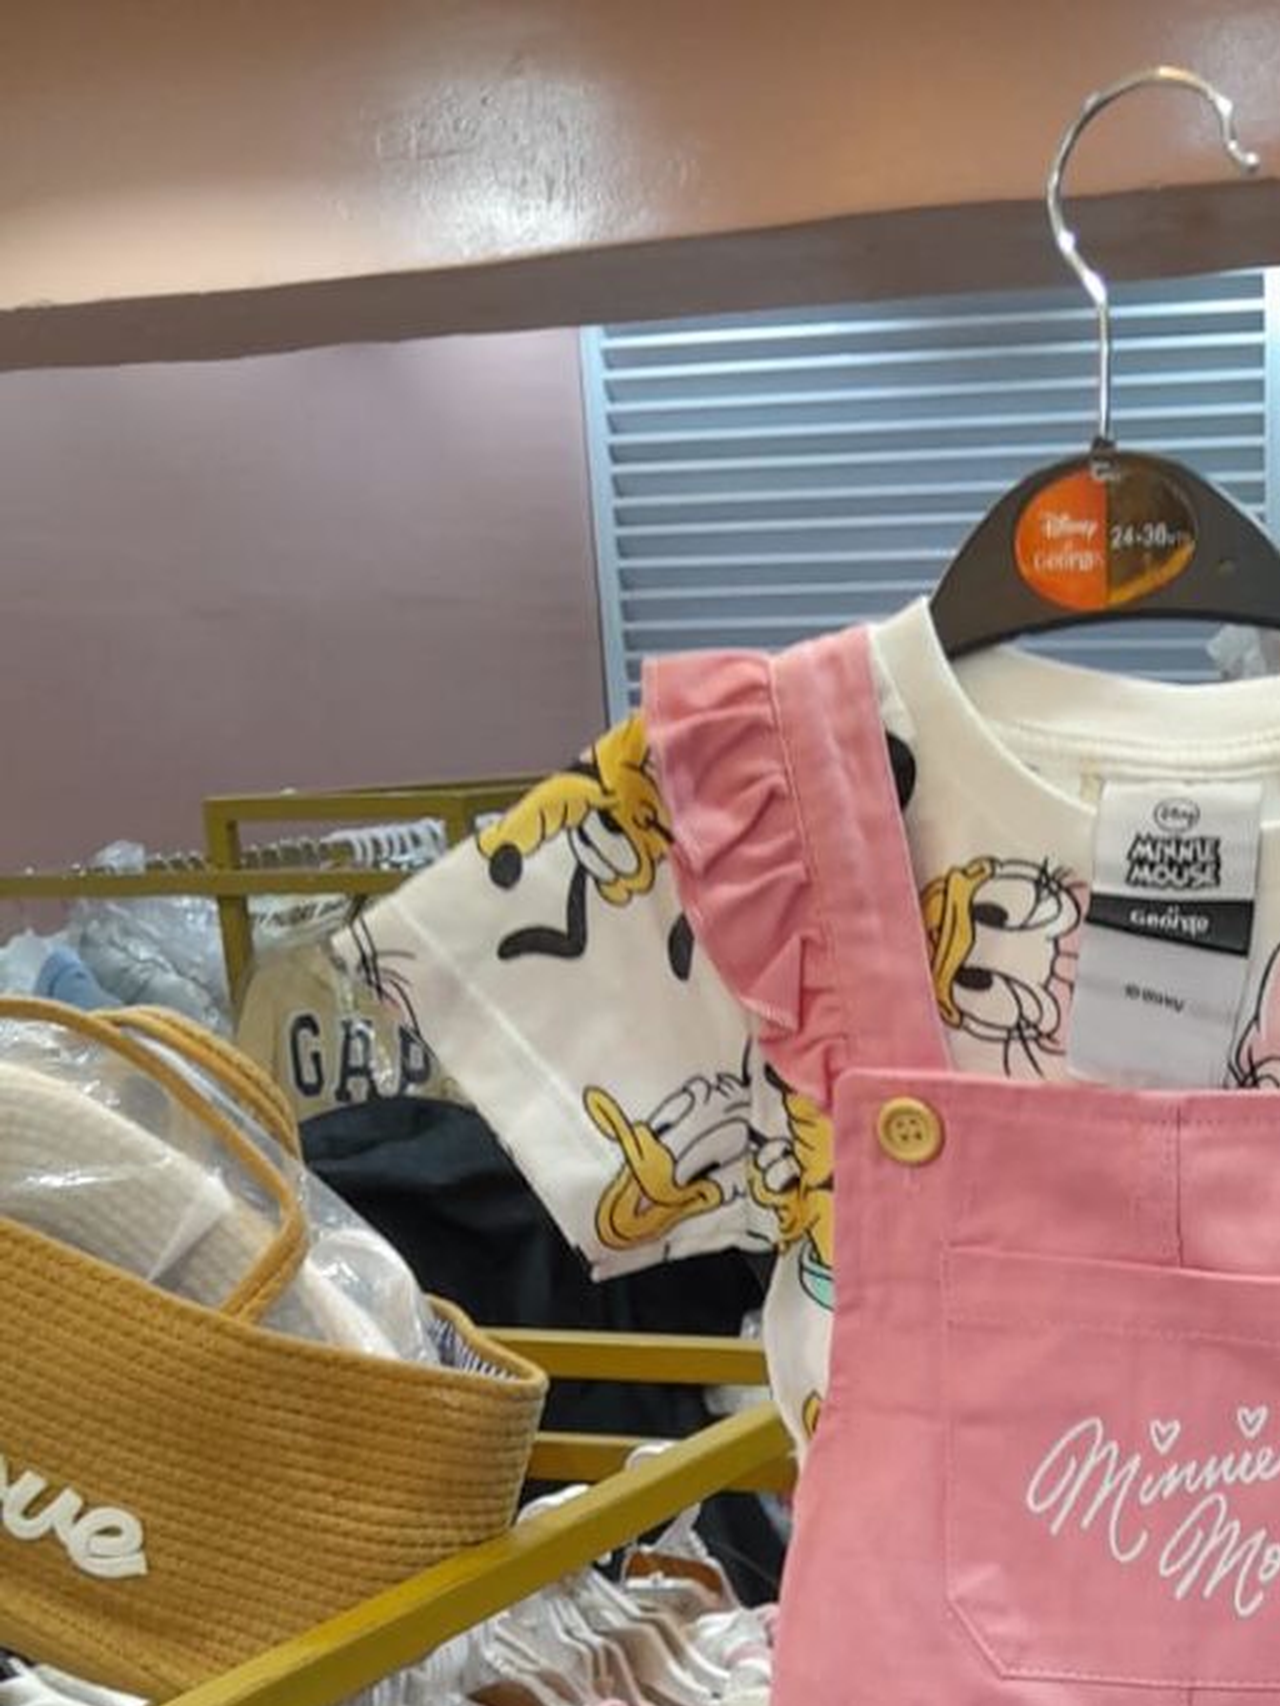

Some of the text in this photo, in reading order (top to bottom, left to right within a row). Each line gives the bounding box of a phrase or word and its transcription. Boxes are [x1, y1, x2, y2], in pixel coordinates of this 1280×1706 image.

[1126, 831, 1221, 866] MINNIE
[1125, 860, 1221, 890] MOUSE
[1129, 904, 1209, 937] George
[290, 1014, 431, 1102] GAP
